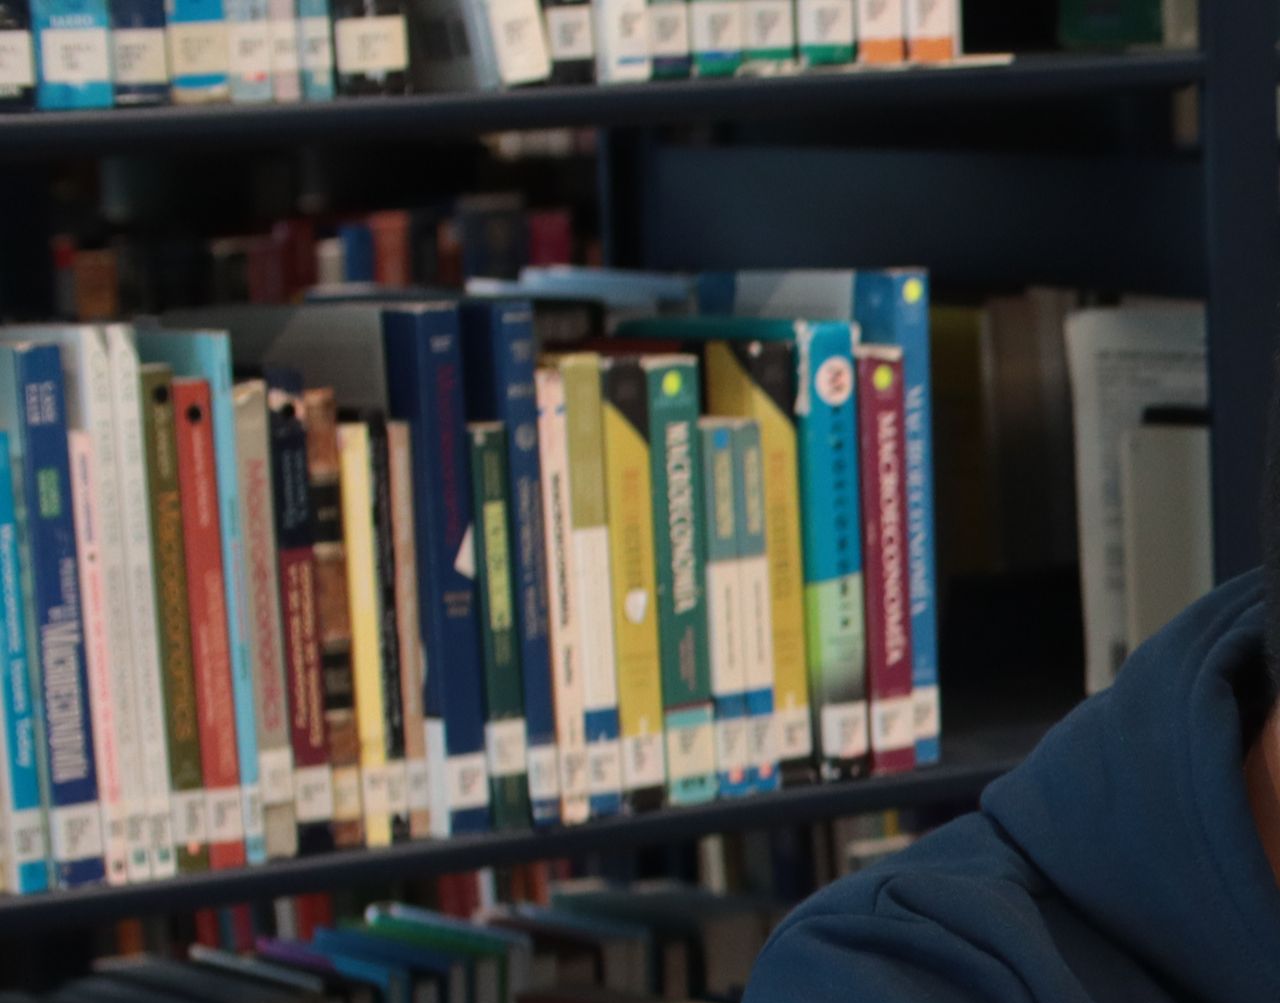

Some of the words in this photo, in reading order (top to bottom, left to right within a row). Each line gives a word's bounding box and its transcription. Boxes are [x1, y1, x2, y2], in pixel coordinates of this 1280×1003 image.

[156, 489, 194, 743] Macroeconomics
[664, 420, 699, 615] MACROECONOMÍA
[876, 410, 906, 666] MACROECONOMÍA
[14, 716, 33, 768] Today
